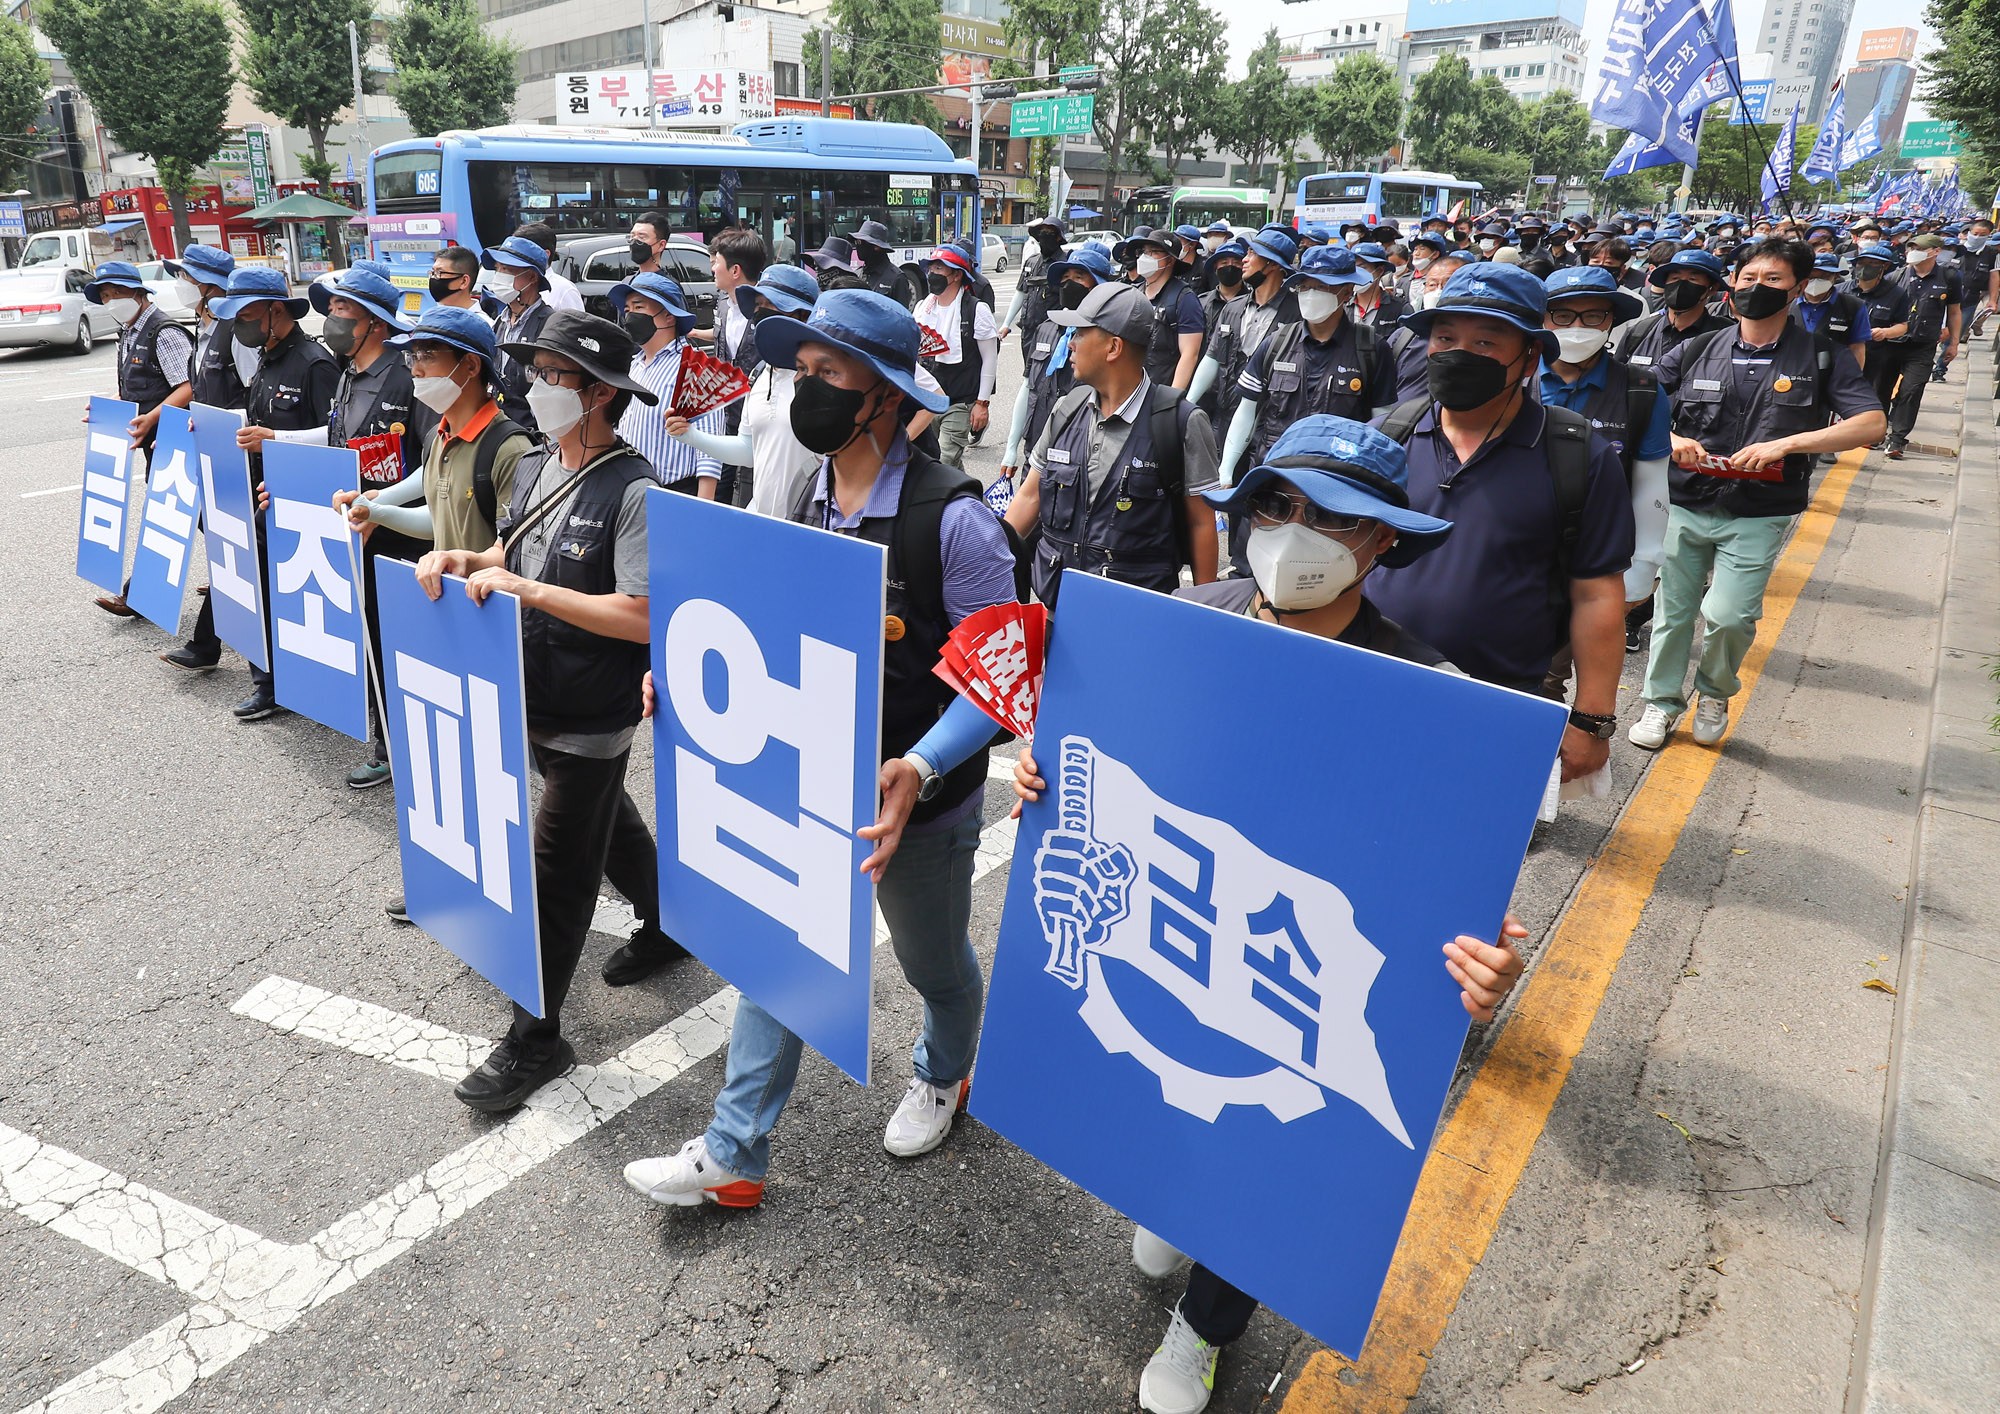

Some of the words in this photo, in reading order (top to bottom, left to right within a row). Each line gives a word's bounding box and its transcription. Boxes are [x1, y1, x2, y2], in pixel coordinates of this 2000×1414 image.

[1791, 2, 1801, 18] THE
[943, 22, 977, 47] 마사지
[1781, 18, 1798, 64] DESIGNERS
[567, 75, 590, 114] 동원
[599, 73, 727, 108] 부동산
[738, 72, 747, 104] 동원
[748, 74, 773, 106] 부동산
[1776, 84, 1811, 95] 24시간
[617, 104, 723, 118] 712-49
[1022, 106, 1043, 117] 남영역
[1067, 98, 1081, 108] 시청
[1066, 115, 1088, 125] 서울역
[418, 173, 437, 193] 605
[1347, 185, 1364, 196] 421
[887, 189, 903, 206] 605
[1137, 204, 1159, 213] 1711
[83, 432, 128, 553] 금
[142, 448, 198, 588] 속
[200, 453, 257, 615] 노
[274, 497, 357, 676] 조
[395, 650, 521, 914] 파
[665, 598, 858, 975] 업
[1148, 814, 1323, 1070] 금속
